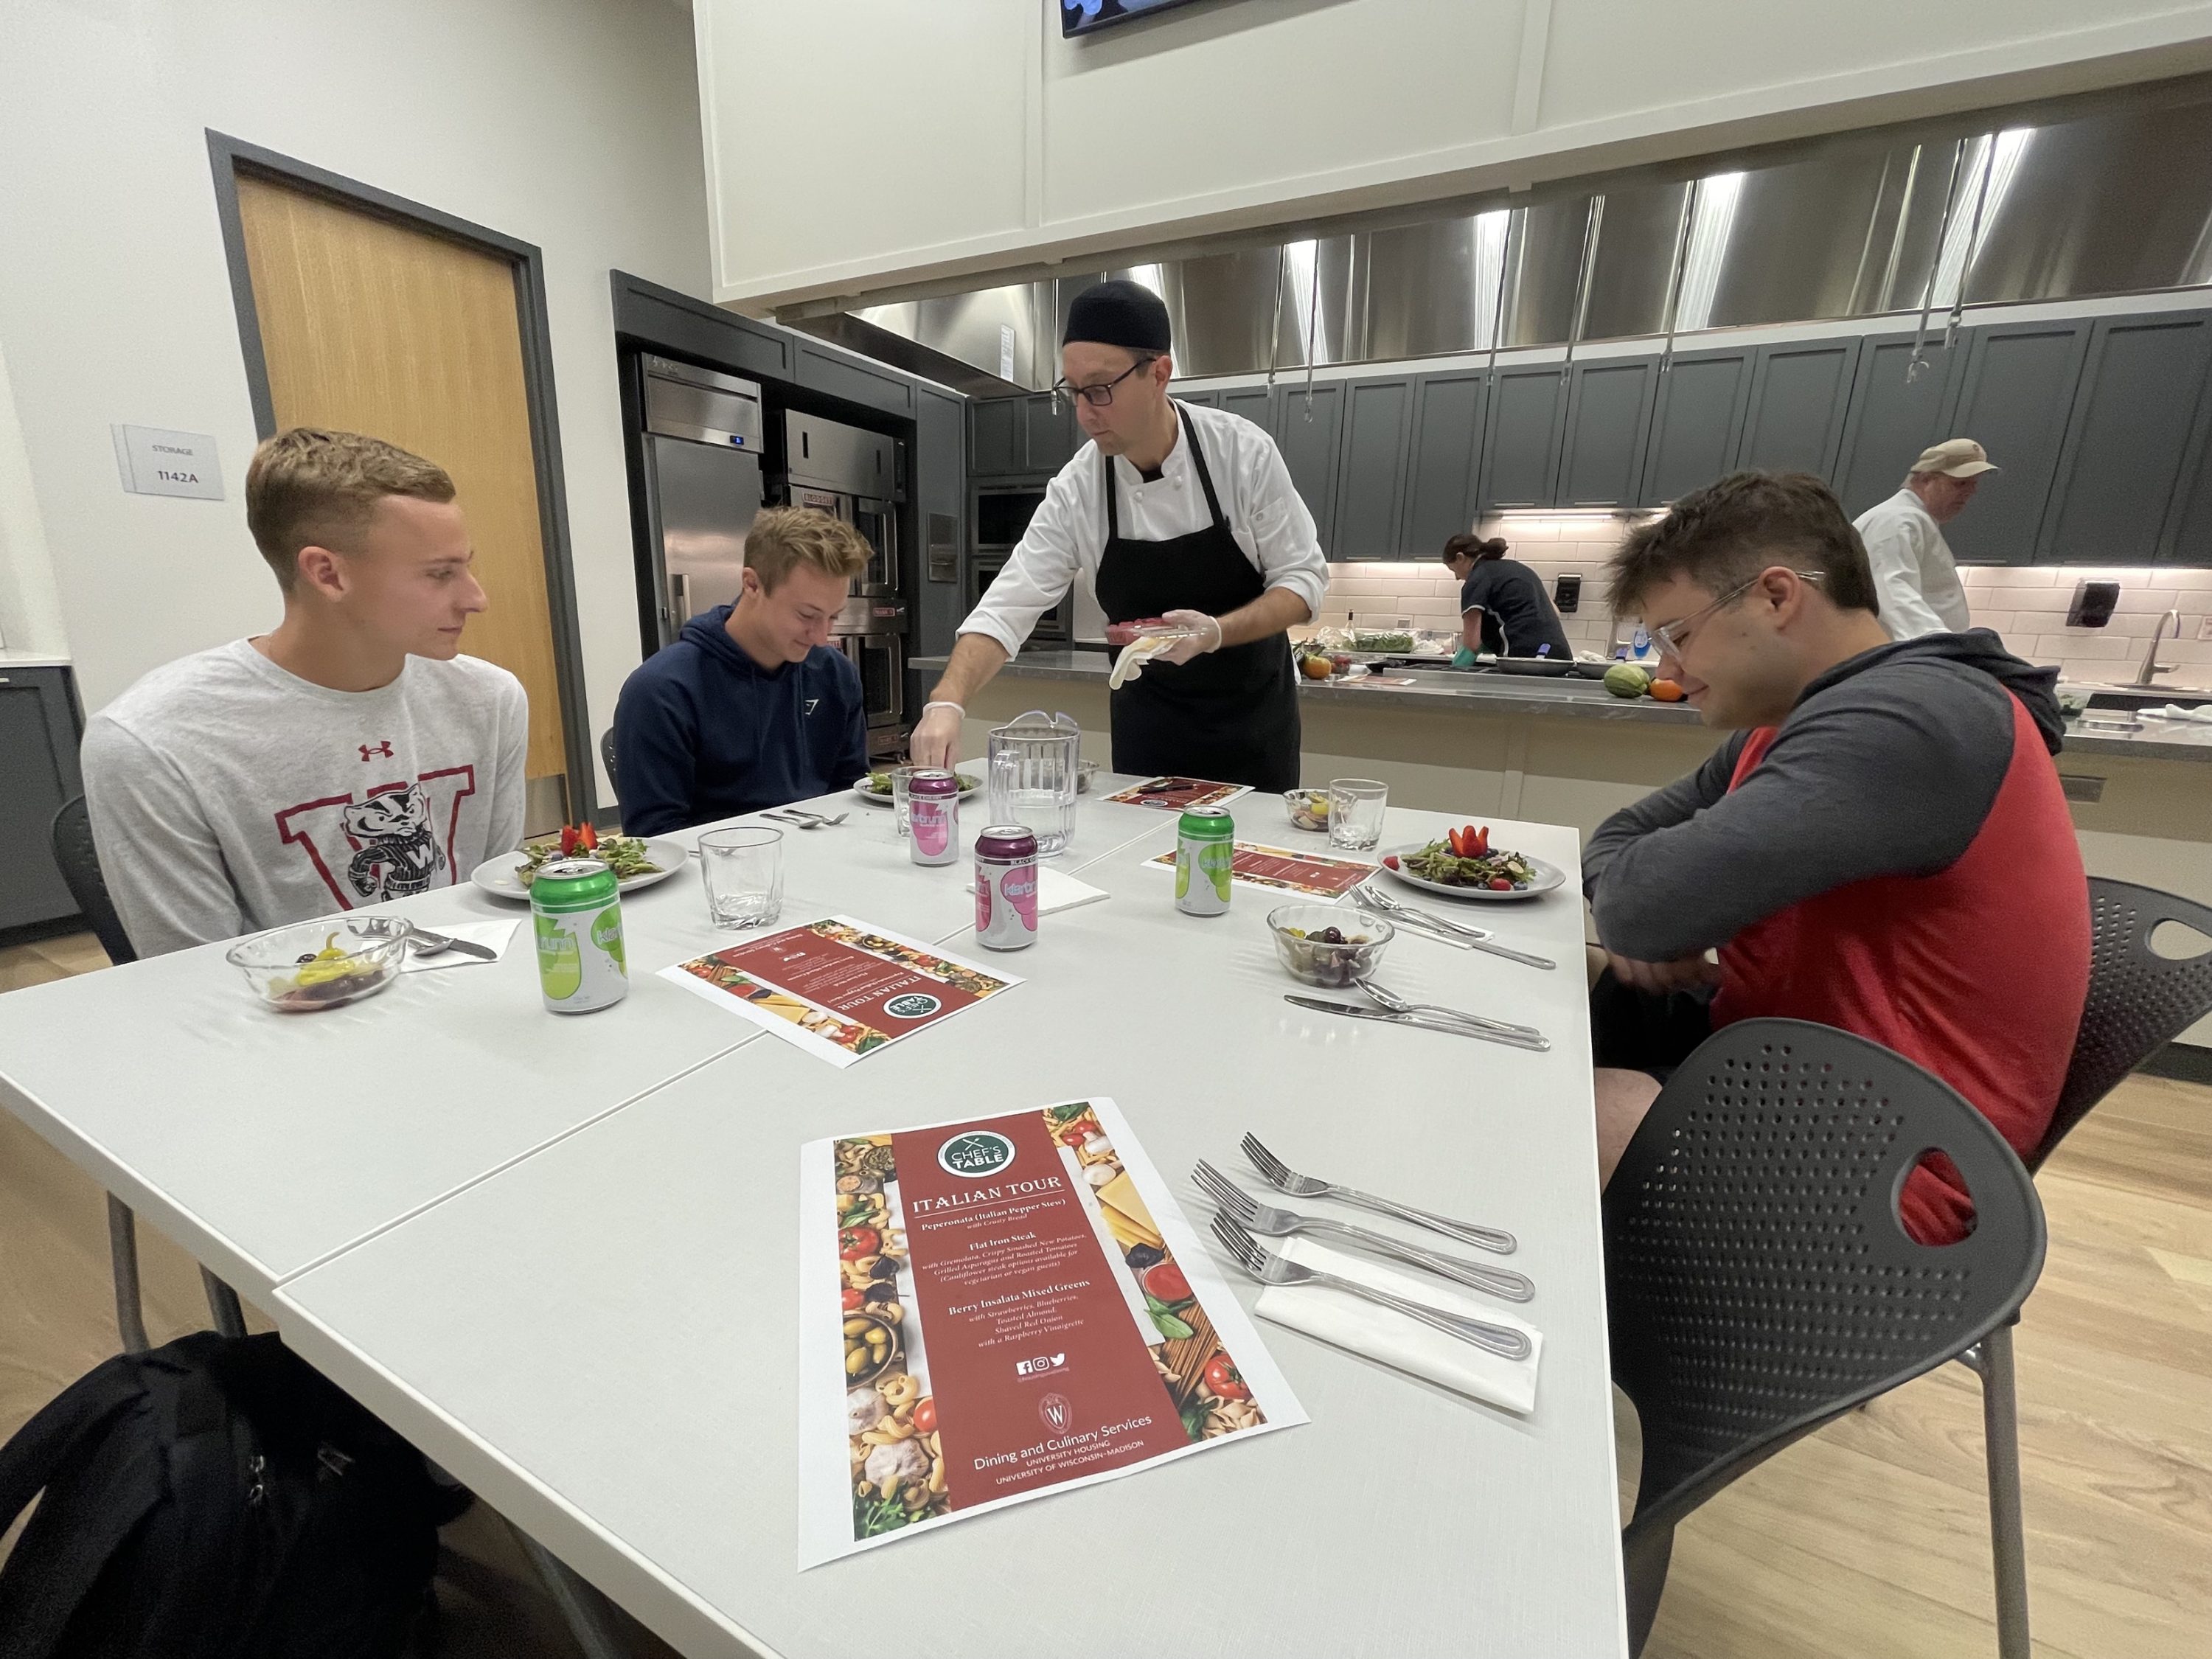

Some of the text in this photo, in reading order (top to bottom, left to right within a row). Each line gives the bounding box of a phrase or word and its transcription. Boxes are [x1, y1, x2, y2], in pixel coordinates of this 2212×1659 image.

[152, 445, 193, 456] STORAGE
[158, 470, 199, 484] 1142A
[872, 975, 922, 997] ITALIAN
[838, 995, 874, 1011] TOUR
[890, 995, 923, 1011] TABLE
[897, 998, 928, 1014] CHEF'S
[951, 1146, 1001, 1161] CHEF'S
[952, 1154, 1004, 1169] TABLE
[912, 1176, 1062, 1213] ITALIAN TOUR
[921, 1198, 1066, 1231] Peperonata (Italian Pepper Stew)
[967, 1221, 983, 1229] with
[1008, 1214, 1028, 1222] Bread
[969, 1231, 1037, 1251] Flat Iron Steak
[982, 1248, 1006, 1258] Crispy
[1006, 1242, 1037, 1252] Smashed
[933, 1243, 1077, 1276] Grilled Asparagus and Roasted Tomatoes
[940, 1250, 1078, 1283] (Cauliflower steak options available for
[964, 1273, 1003, 1286] vegetarian
[1014, 1266, 1034, 1275] vegan
[1036, 1261, 1061, 1271] guests)
[948, 1279, 1091, 1315] Berry Insalata Mixed Greens
[969, 1312, 986, 1323] with
[995, 1315, 1063, 1335] Shaved Red Onion
[996, 1315, 1024, 1325] Toasted
[978, 1338, 995, 1348] with
[1004, 1328, 1043, 1342] Raspberry
[1044, 1318, 1085, 1332] Vinaigrette
[973, 1416, 1152, 1470] Dining and Culinary Services
[995, 1440, 1145, 1485] UNIVERSITY OF WISCONSIN-MADISON
[1026, 1440, 1111, 1467] UNIVERSITY HOUSING
